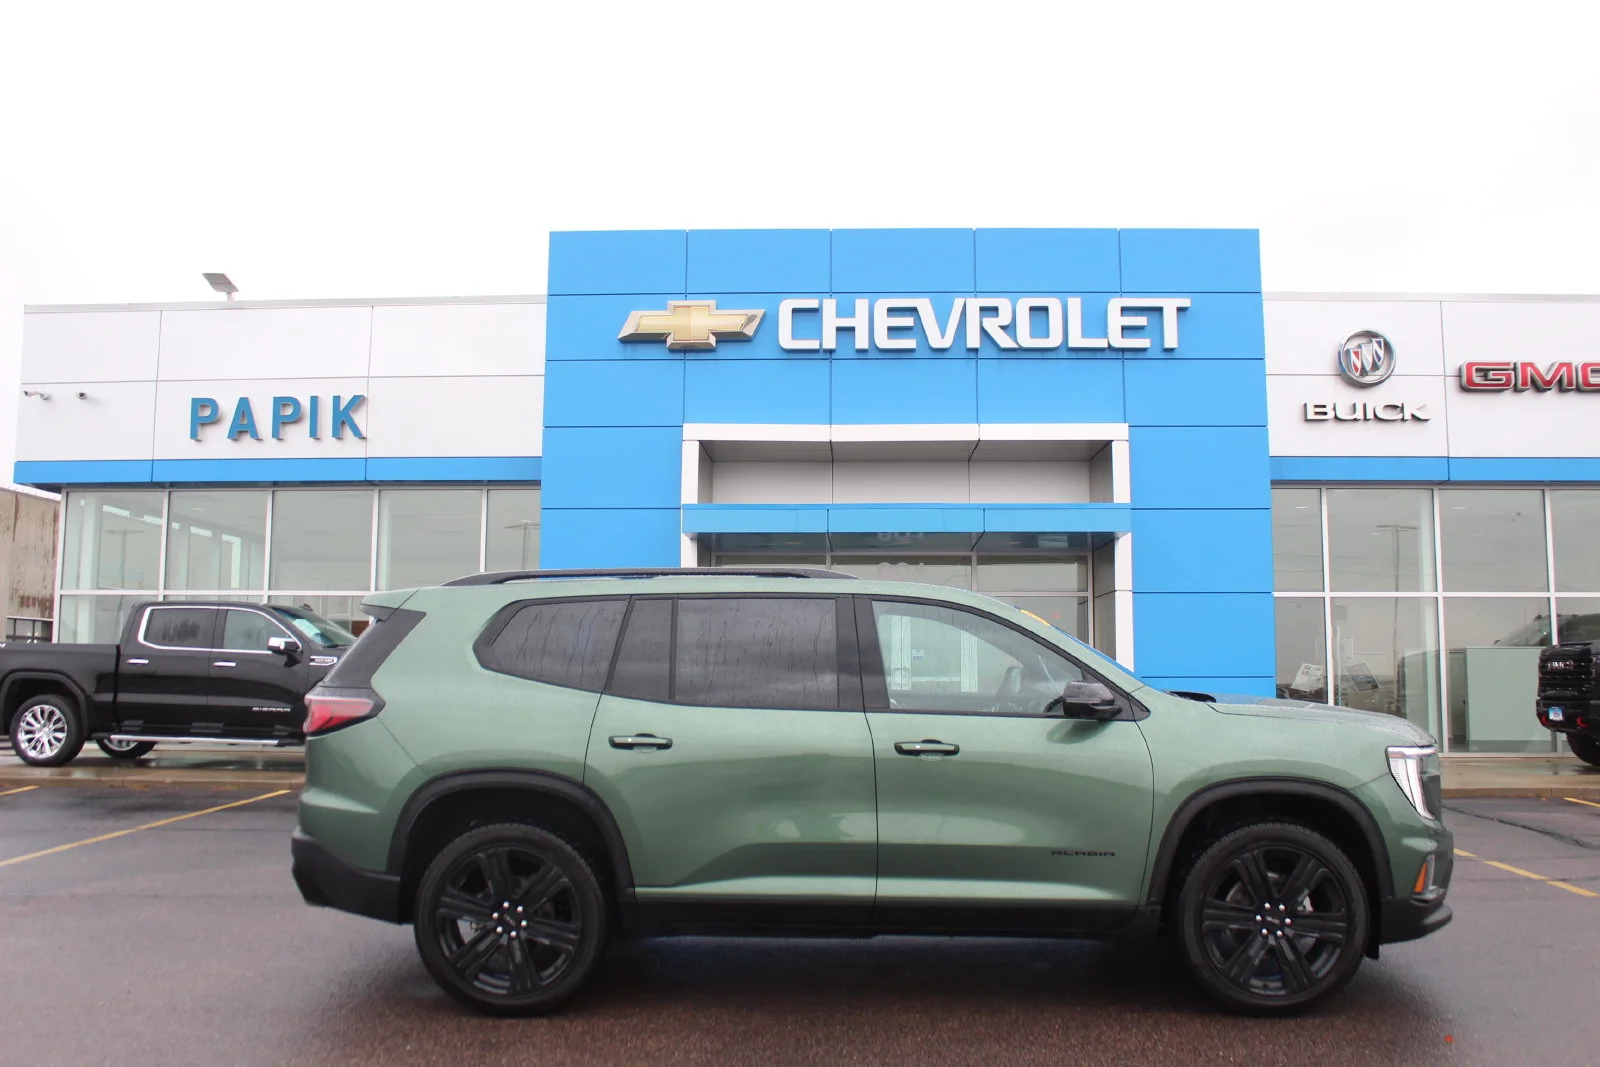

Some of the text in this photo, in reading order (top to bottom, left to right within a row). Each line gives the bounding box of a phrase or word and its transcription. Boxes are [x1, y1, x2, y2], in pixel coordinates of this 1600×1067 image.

[778, 297, 1191, 350] CHEVROLET
[190, 395, 367, 441] PAPIK
[1302, 401, 1431, 422] BUICK
